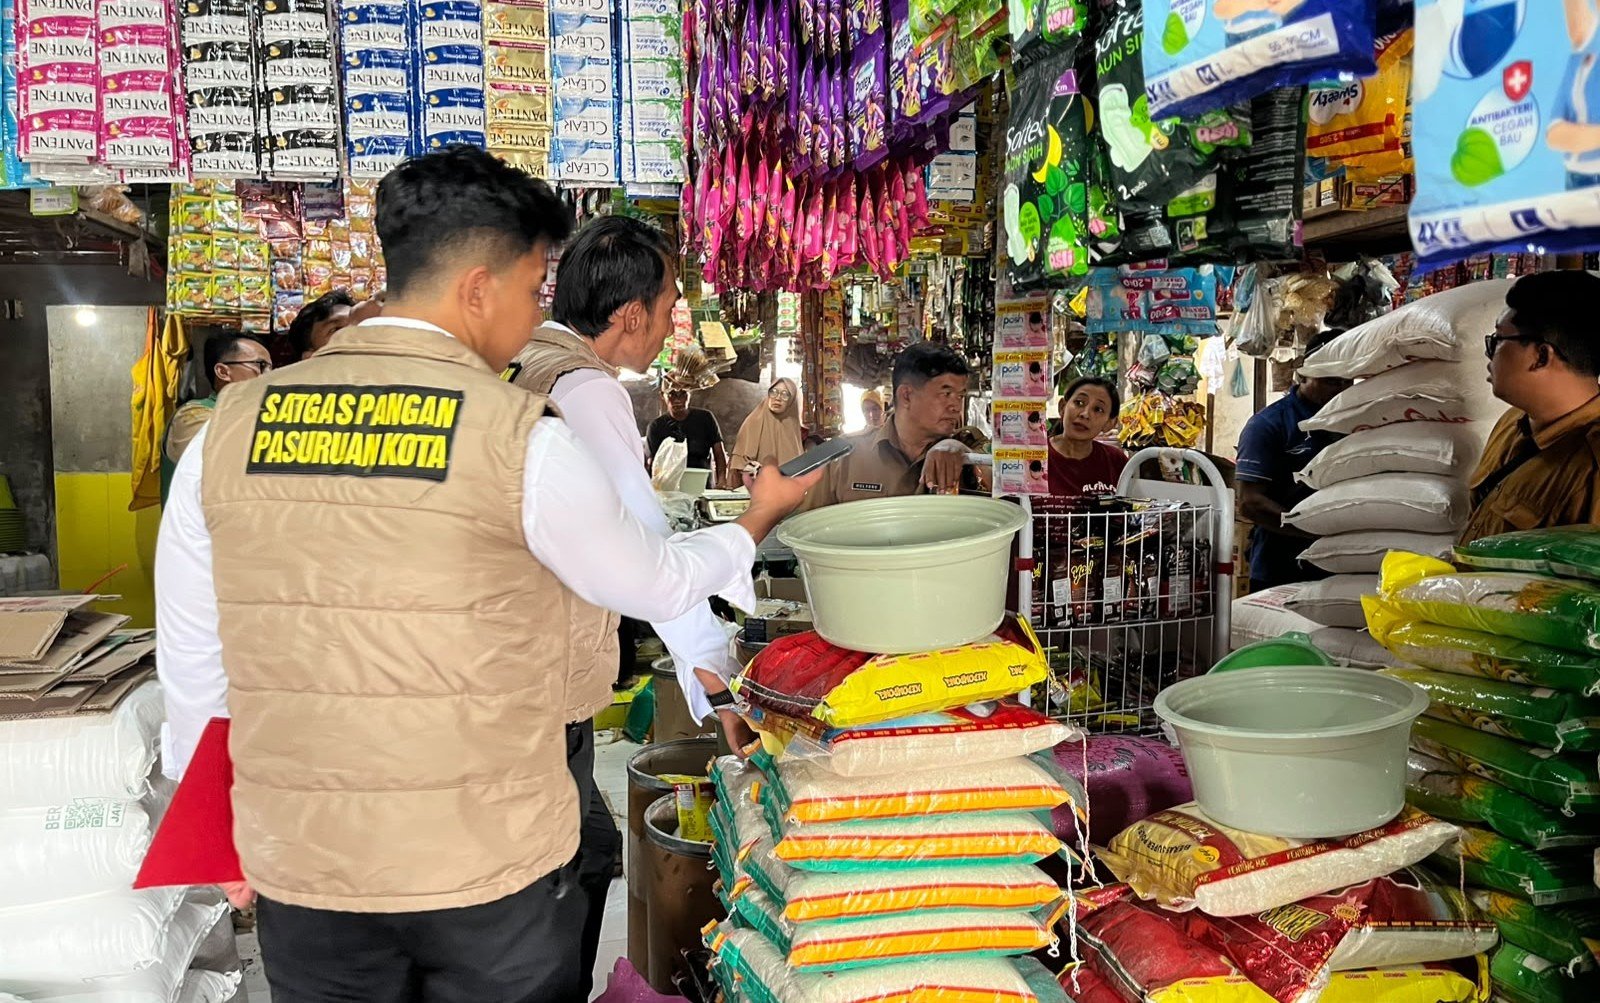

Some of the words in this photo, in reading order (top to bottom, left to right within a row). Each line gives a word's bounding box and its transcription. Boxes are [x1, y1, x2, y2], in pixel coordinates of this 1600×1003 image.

[102, 5, 162, 18] PANTENE
[426, 25, 478, 40] PANTENE
[31, 43, 92, 57] PANTENE
[561, 35, 606, 52] CLEAR
[104, 51, 165, 65] PANTENE
[428, 68, 480, 83] PANTENE
[562, 78, 606, 94] CLEAR
[32, 89, 93, 103] PANTENE
[1312, 84, 1358, 107] Sweety
[107, 98, 168, 111] PANTENE
[194, 111, 251, 126] PANTENE
[430, 112, 482, 126] PANTENE
[1470, 102, 1533, 126] ANTIBAKTERI
[564, 120, 608, 136] CLEAR
[1493, 116, 1533, 136] CEGAH
[32, 136, 94, 149] PANTENE
[1500, 132, 1522, 147] BAU
[109, 144, 170, 157] PANTENE
[565, 162, 610, 178] CLEAR
[1118, 184, 1132, 201] 2
[1002, 312, 1024, 330] posh
[1002, 363, 1024, 378] posh
[260, 392, 356, 426] SATGAS
[354, 392, 458, 428] PANGAN
[1002, 410, 1022, 428] posh
[251, 430, 383, 468] PASURUAN
[378, 433, 447, 469] KOTA
[1001, 458, 1023, 475] posh
[45, 805, 62, 831] BER
[108, 802, 122, 824] JAN
[1147, 840, 1168, 855] SUPER
[1165, 844, 1192, 856] BERAS
[1255, 858, 1268, 868] MAS
